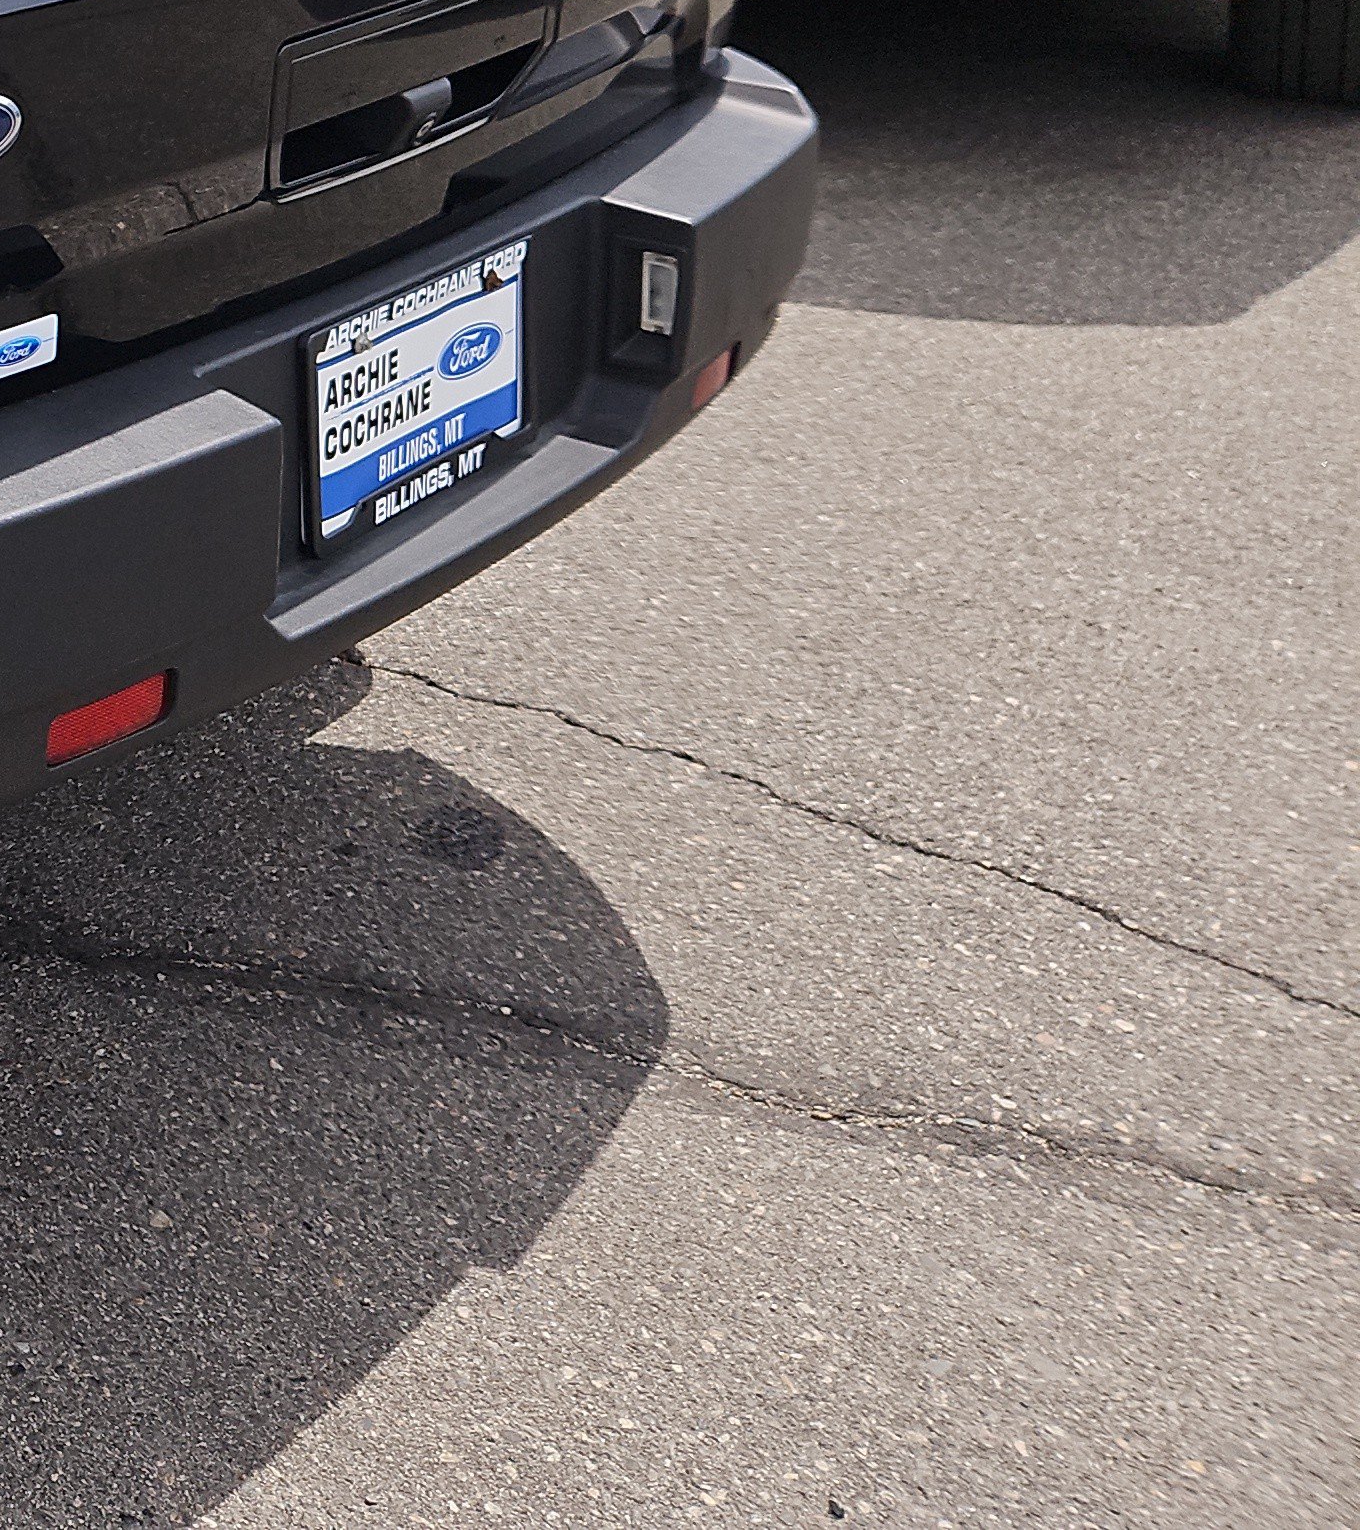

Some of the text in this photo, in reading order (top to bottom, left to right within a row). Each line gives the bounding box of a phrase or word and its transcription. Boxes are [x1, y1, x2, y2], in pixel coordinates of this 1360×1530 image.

[323, 241, 528, 353] ARCHIE COCHRANE FORD
[0, 340, 33, 364] Ford
[323, 348, 400, 414] ARCHIE
[449, 332, 491, 373] Ford
[323, 378, 432, 461] COCHRANE
[378, 412, 466, 482] BILLINGS, MT
[375, 442, 487, 526] BILLINGS, MT
